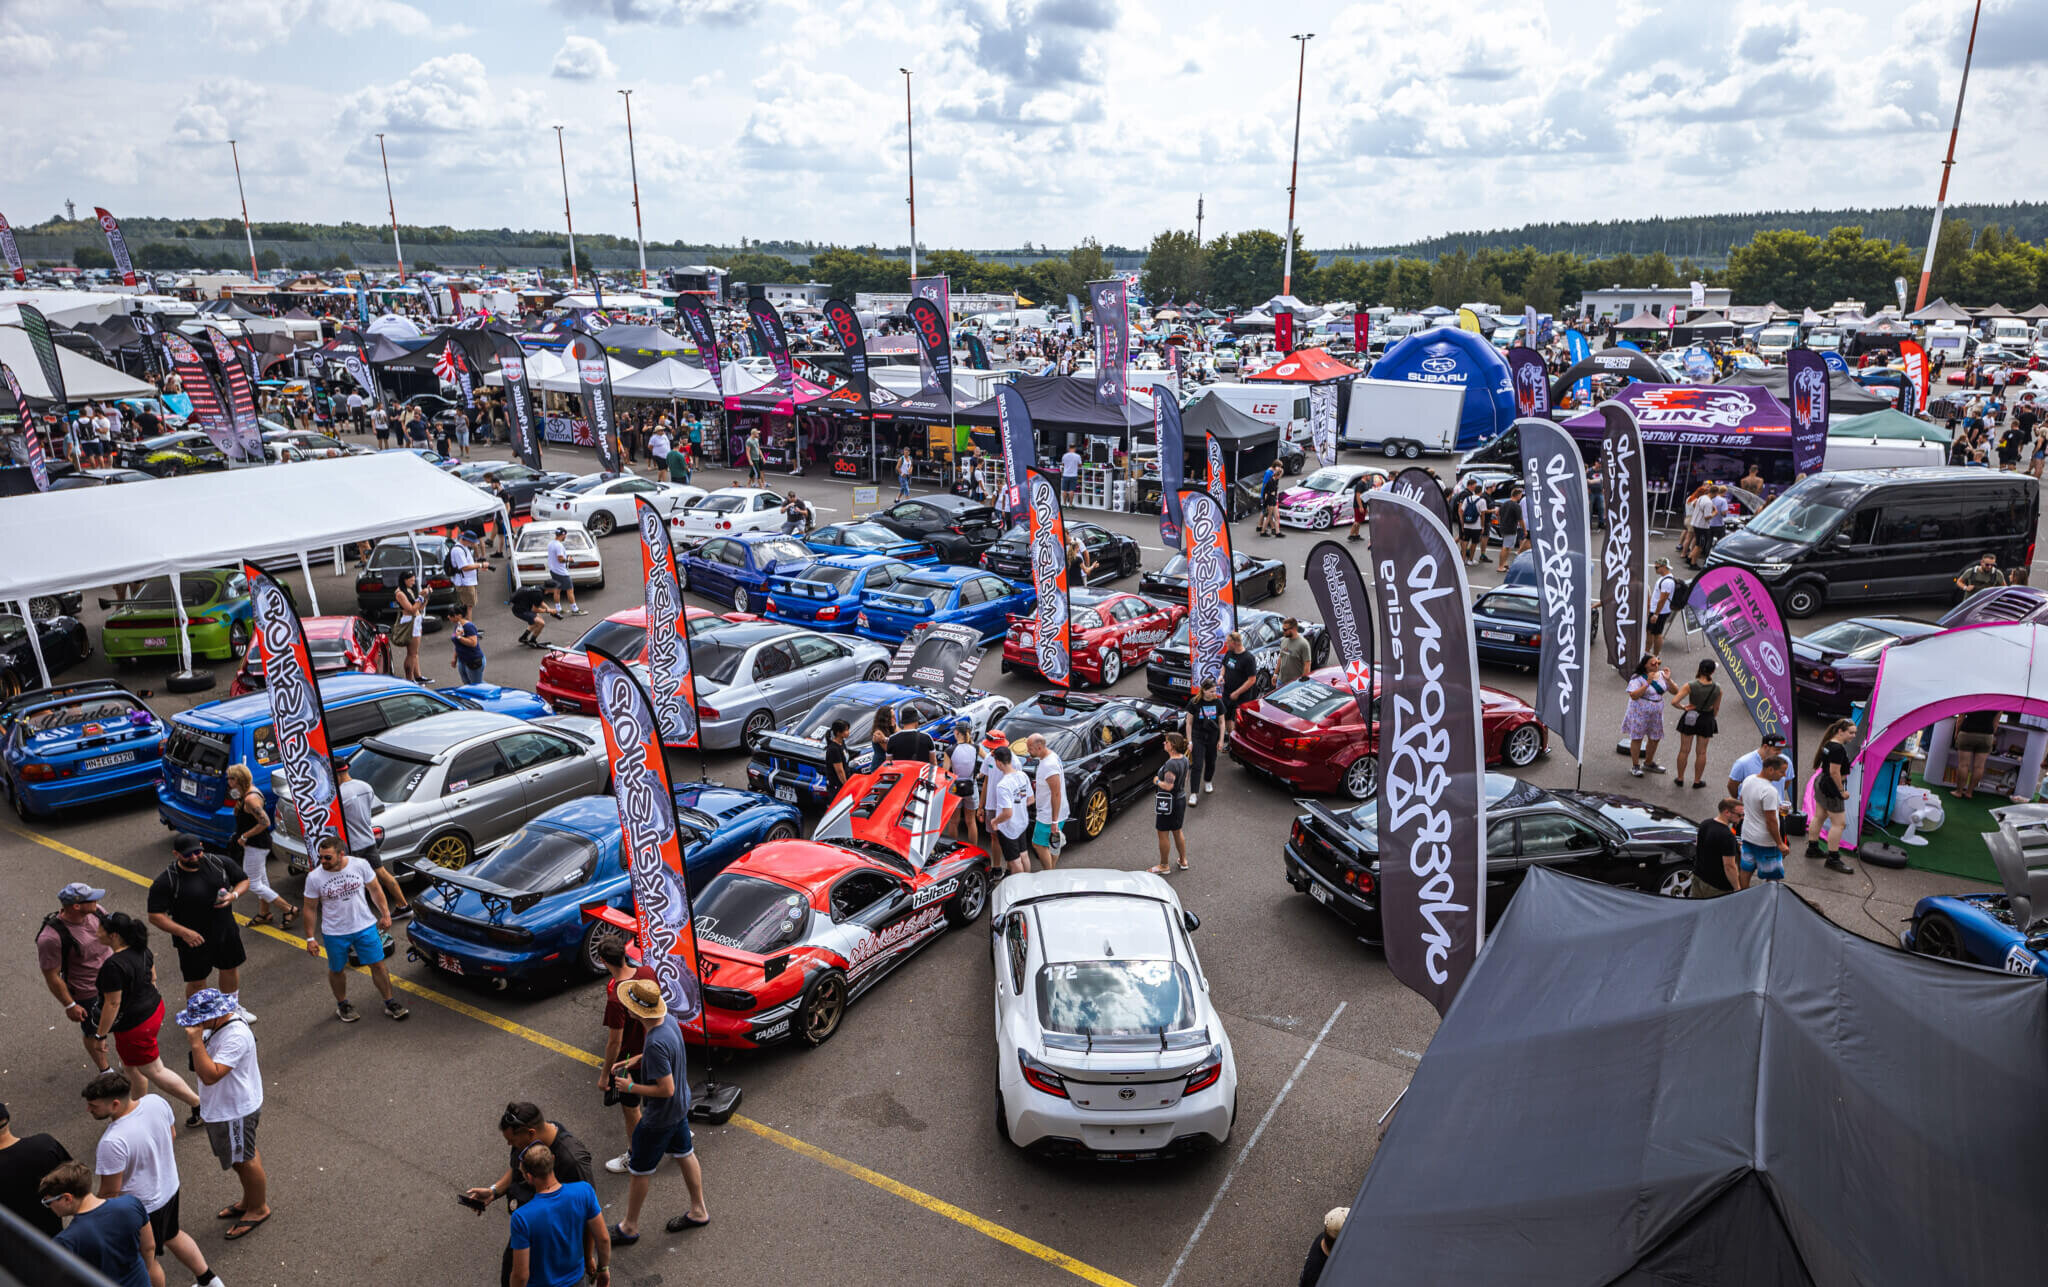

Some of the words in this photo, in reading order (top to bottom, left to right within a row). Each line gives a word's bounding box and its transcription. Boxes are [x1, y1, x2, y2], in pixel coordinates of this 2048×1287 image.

[832, 308, 857, 346] dba
[915, 307, 942, 348] dba
[1408, 373, 1468, 383] SUBARU
[1535, 379, 1544, 412] LINK
[1813, 385, 1821, 422] LINK
[548, 429, 571, 441] TOYOTA
[1679, 433, 1720, 444] STARTS
[1722, 436, 1752, 446] HERE
[835, 459, 856, 472] dba
[85, 759, 97, 769] HN
[913, 878, 960, 909] Haltech
[708, 932, 745, 950] PARRISH
[1044, 966, 1078, 981] 172
[755, 1018, 789, 1041] TAKATA
